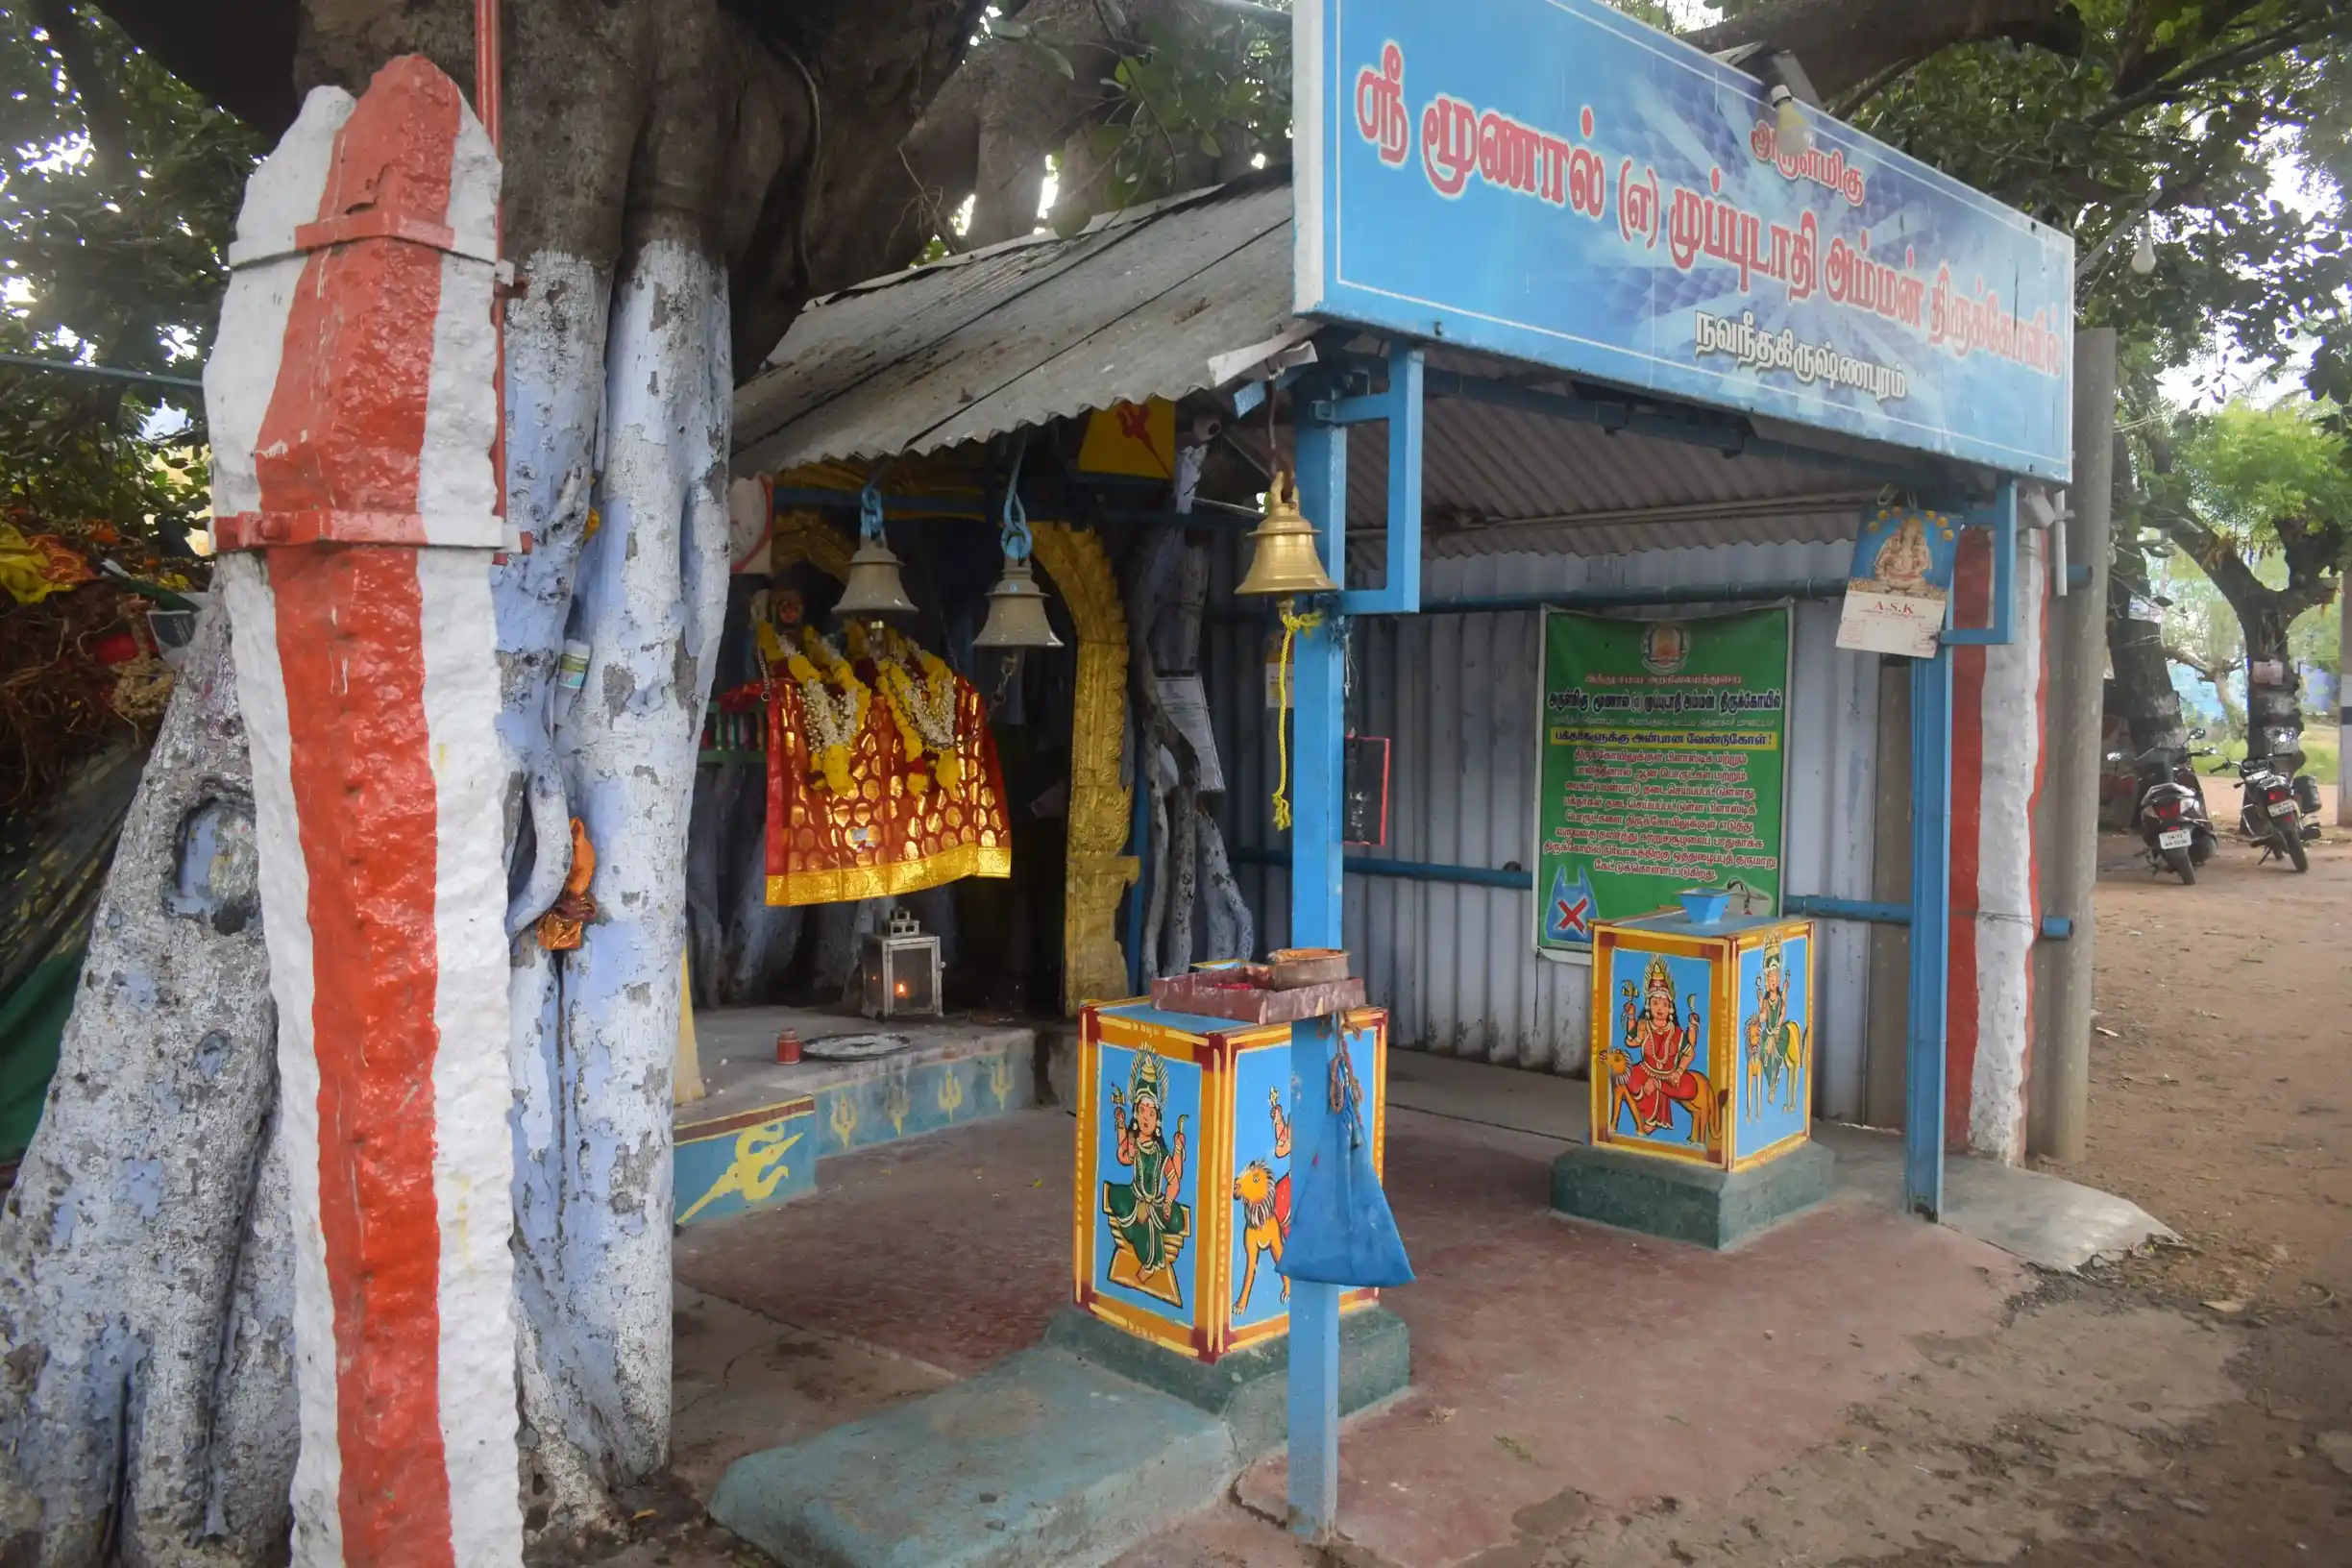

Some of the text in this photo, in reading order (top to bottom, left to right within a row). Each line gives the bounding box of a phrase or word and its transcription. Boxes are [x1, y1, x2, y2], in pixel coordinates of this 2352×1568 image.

[1356, 42, 1409, 165] ஸ்ரீ
[1618, 159, 1660, 250] (எ)
[1669, 166, 1819, 301] முப்புடாதி
[1825, 229, 1924, 331] அம்மன்
[1695, 310, 1907, 401] நவநீதகிருஷ்ணபுரம்
